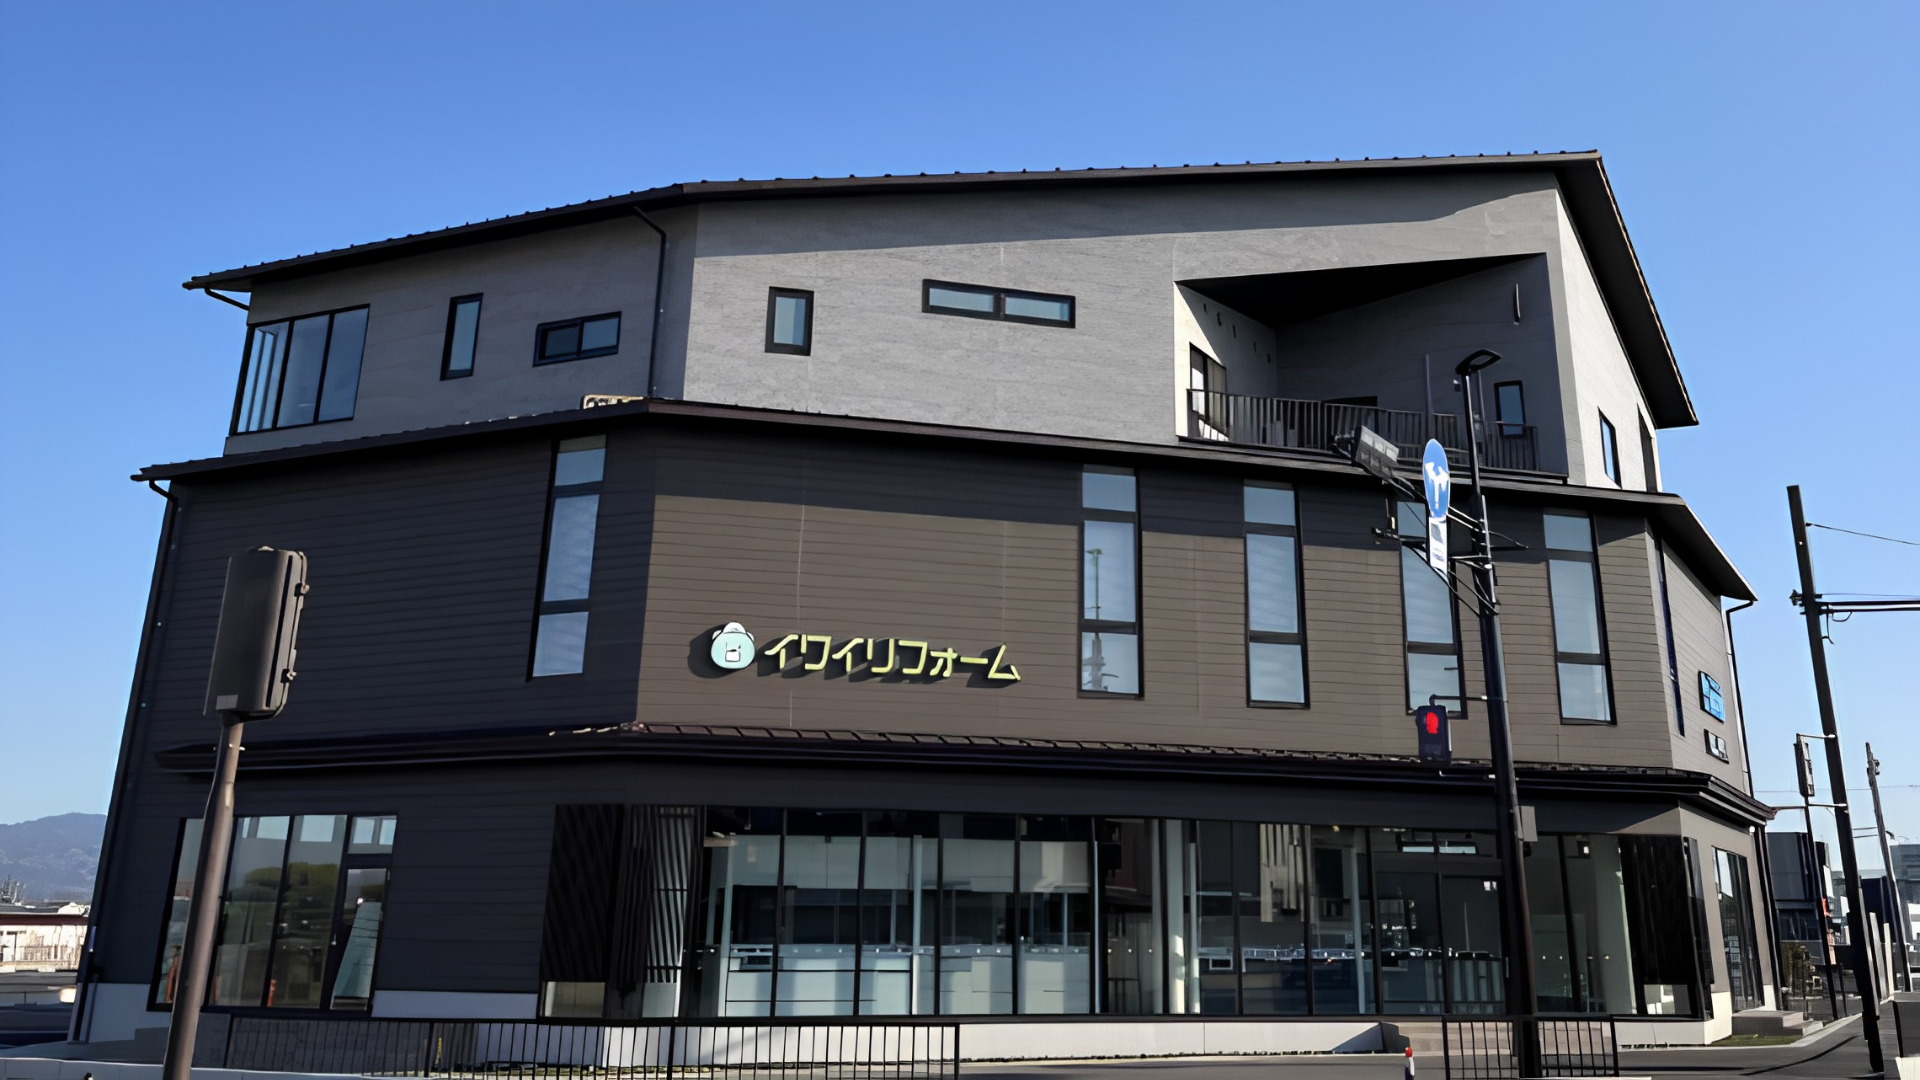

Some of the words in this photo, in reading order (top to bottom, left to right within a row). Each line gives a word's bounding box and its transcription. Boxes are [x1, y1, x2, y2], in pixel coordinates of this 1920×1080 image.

[764, 633, 1021, 682] イワイリフォーム
